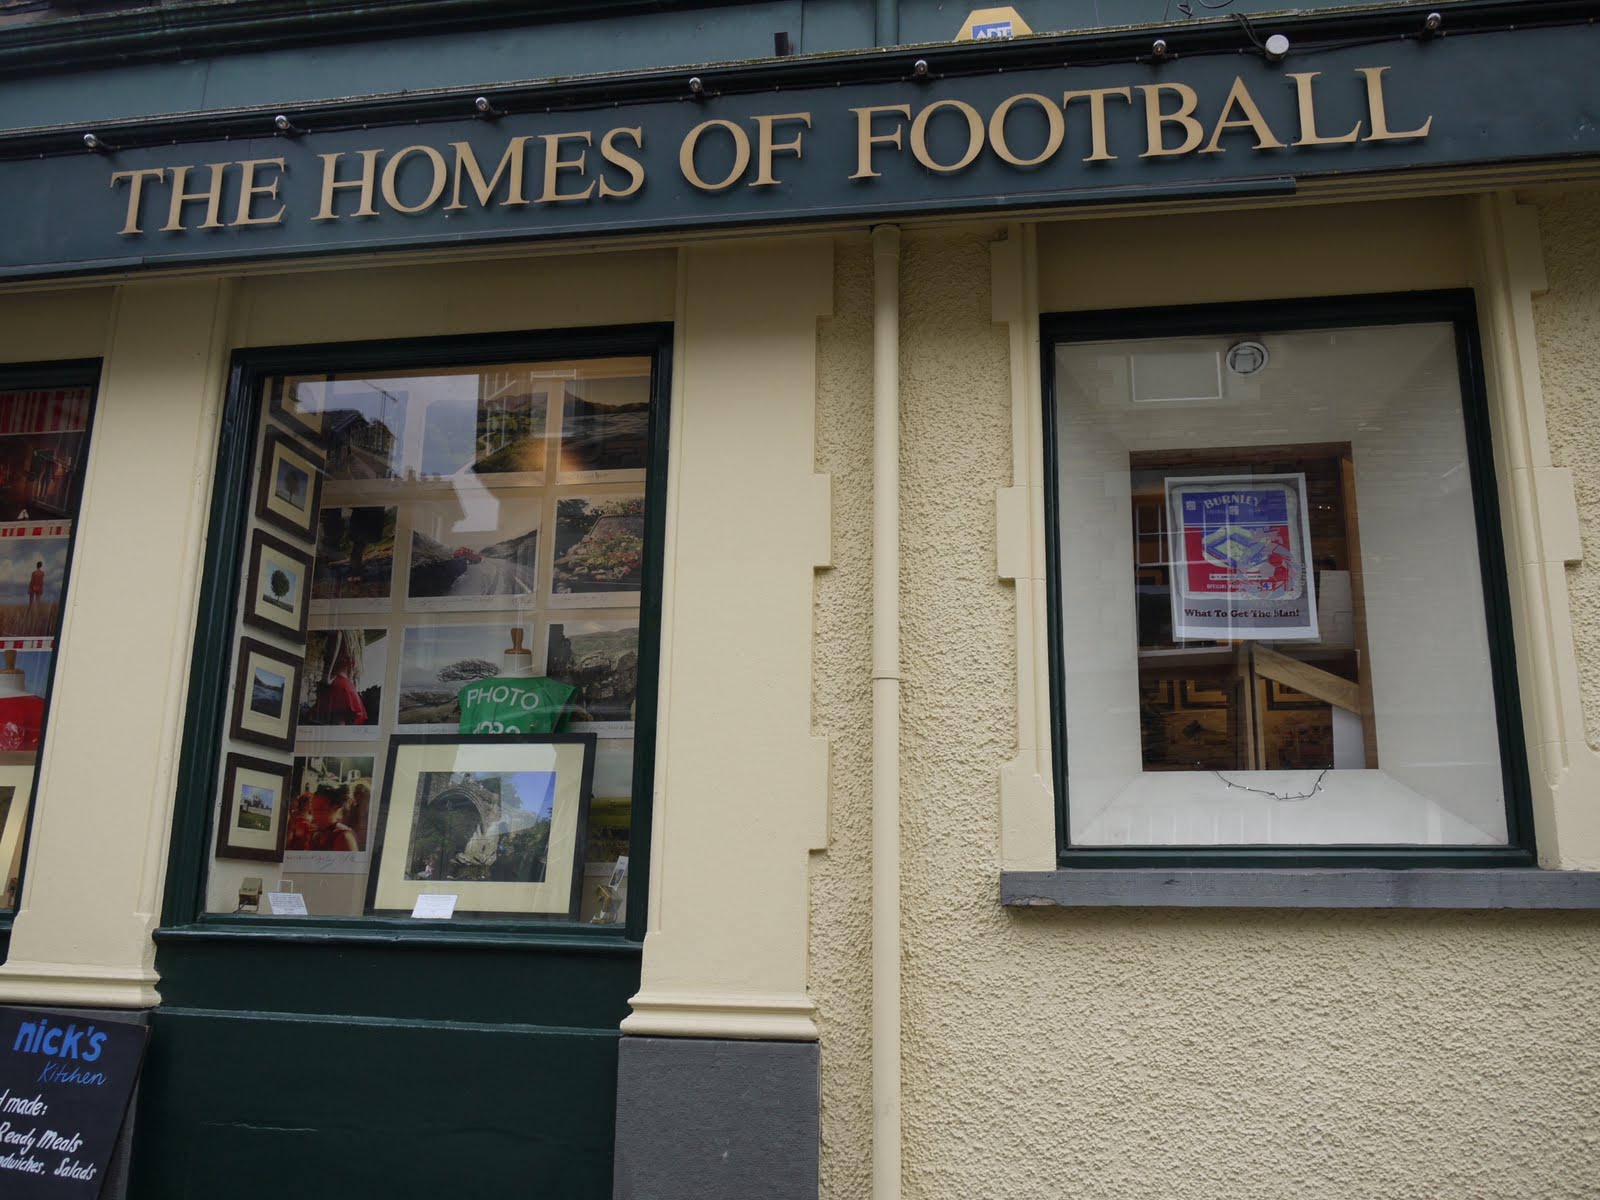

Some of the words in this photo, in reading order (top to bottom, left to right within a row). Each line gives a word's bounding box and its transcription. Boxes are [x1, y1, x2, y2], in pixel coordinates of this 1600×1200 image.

[110, 157, 286, 235] THE
[310, 126, 645, 220] HOMES
[679, 111, 811, 190] OF
[847, 66, 1433, 180] FOOTBALL
[1184, 609, 1212, 617] What
[1214, 609, 1228, 617] To
[1230, 609, 1249, 618] Get
[1251, 609, 1271, 618] The
[1273, 608, 1300, 617] Man!
[466, 686, 539, 710] PHOTO
[37, 1060, 108, 1086] Kitchen
[3, 1093, 48, 1116] made:
[36, 1129, 84, 1153] Meals
[53, 1157, 97, 1180] Salads
